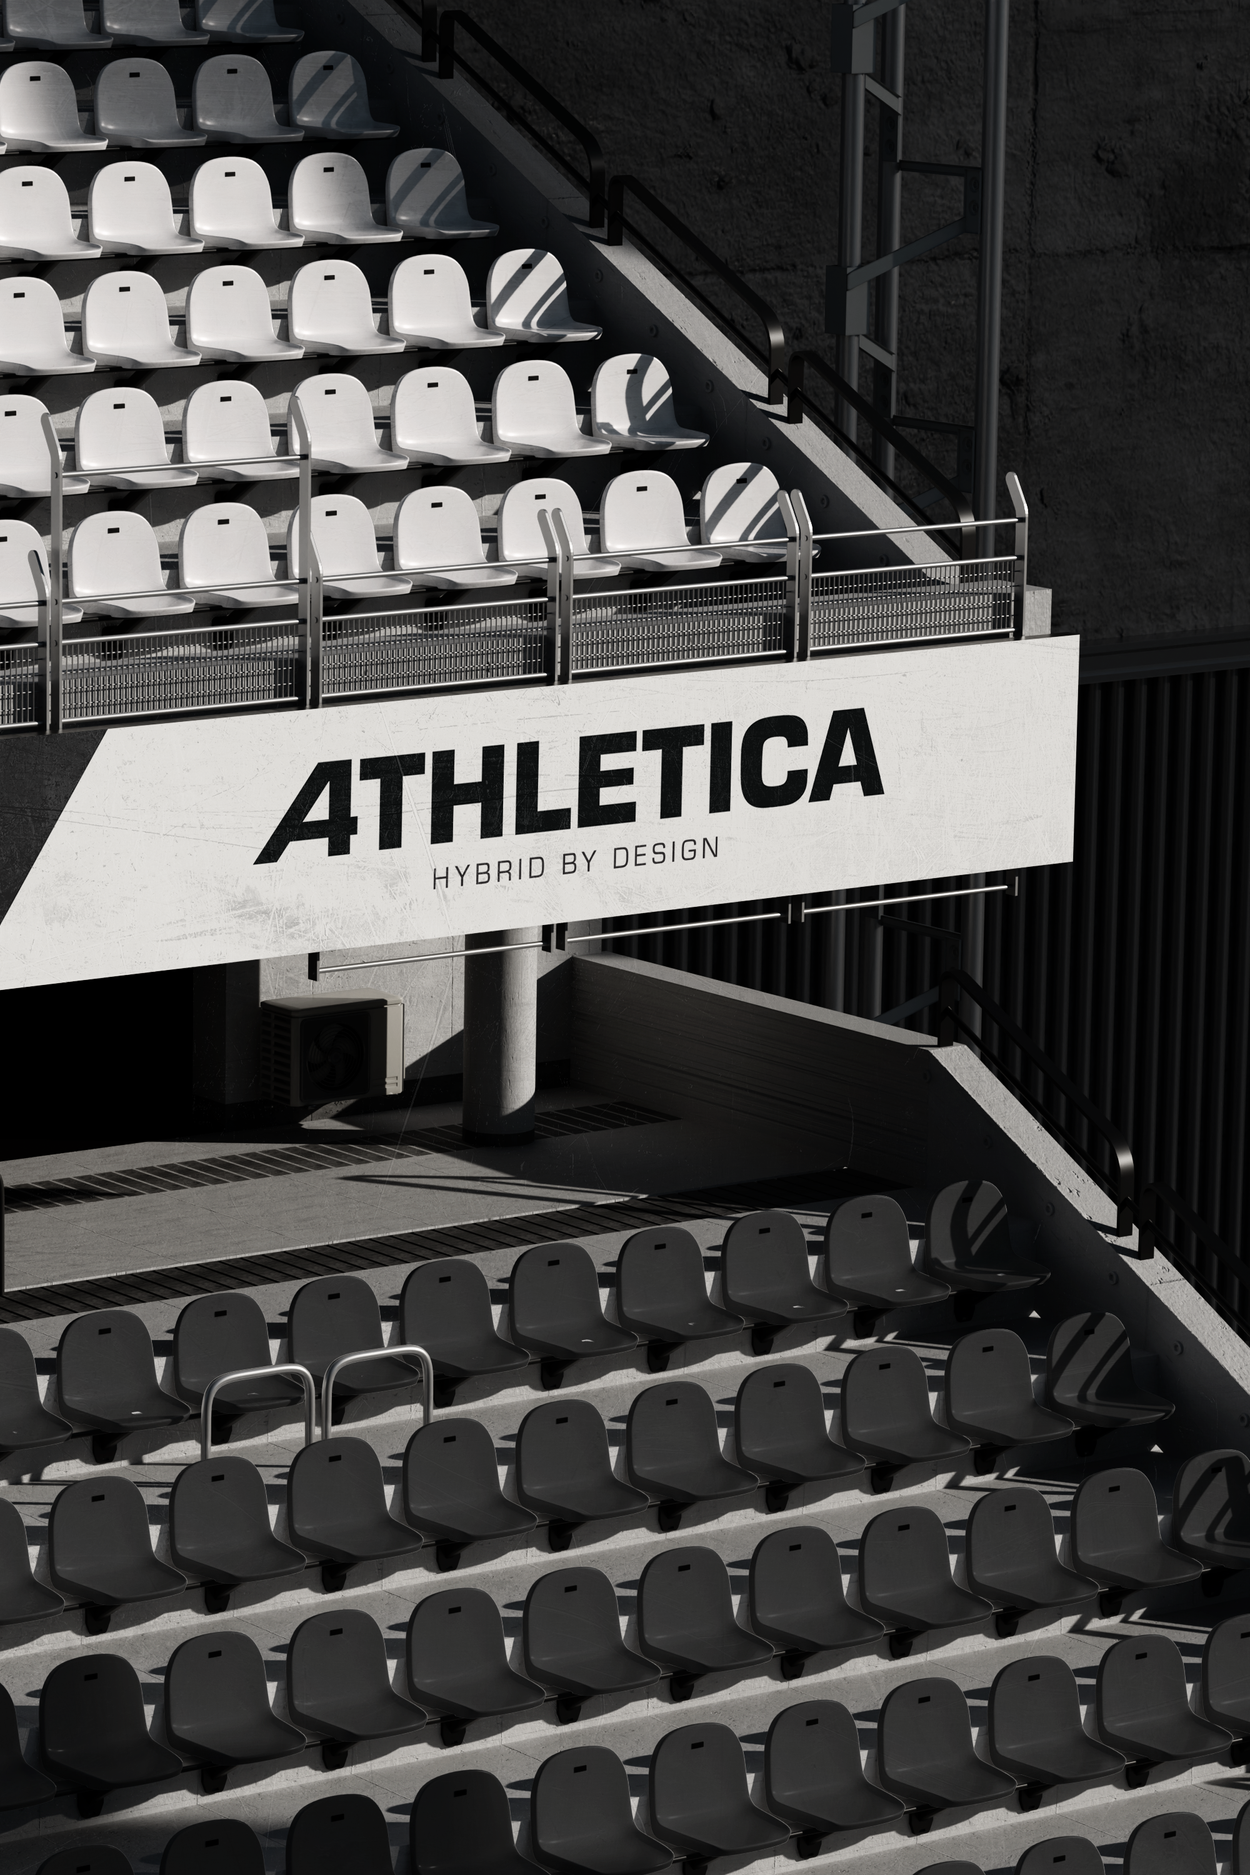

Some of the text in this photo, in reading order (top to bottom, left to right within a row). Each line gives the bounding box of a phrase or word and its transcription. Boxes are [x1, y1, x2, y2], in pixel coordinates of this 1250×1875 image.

[433, 836, 719, 890] HYBRID BY DESIGN
